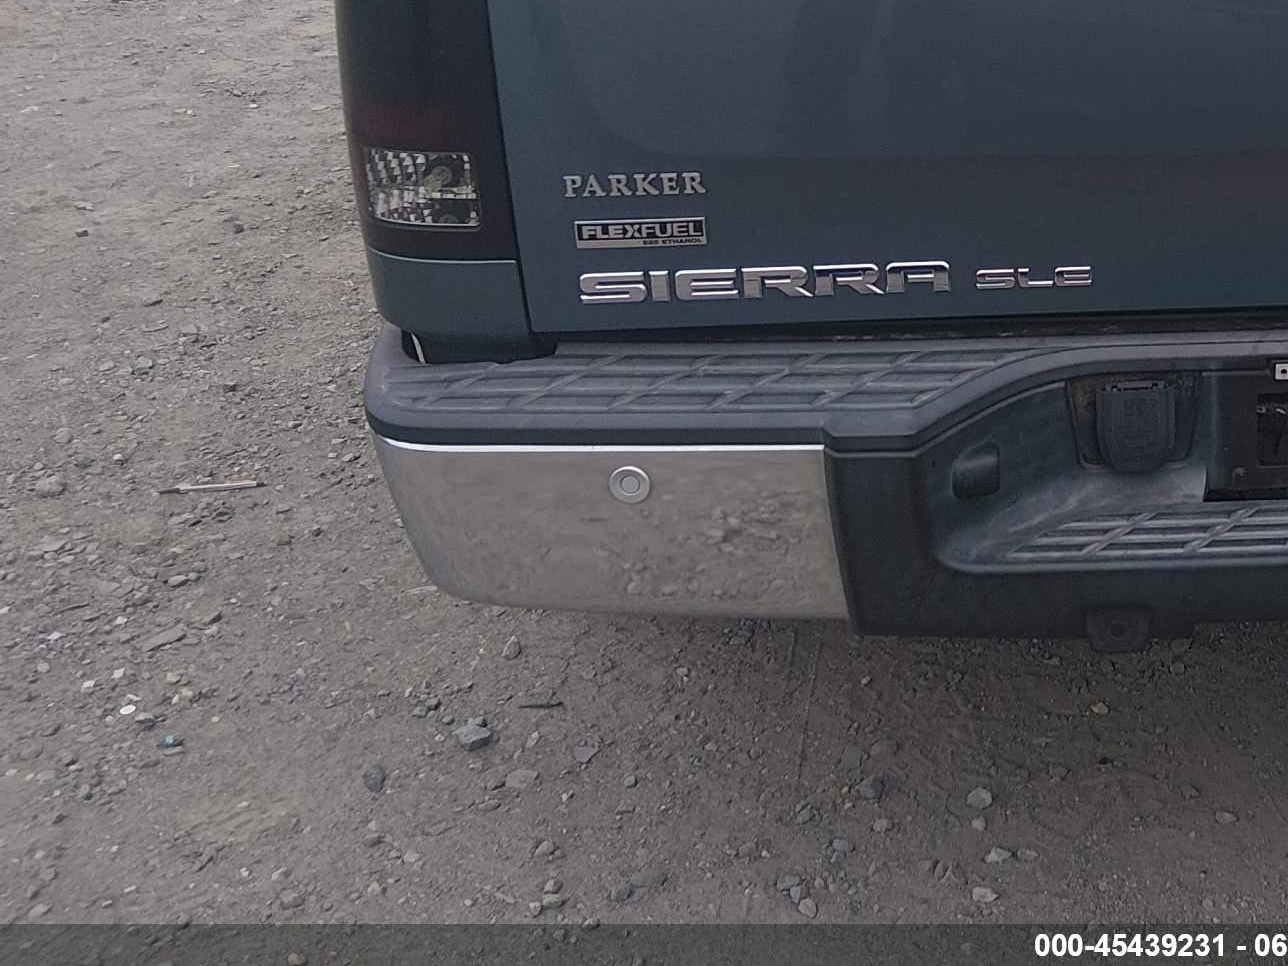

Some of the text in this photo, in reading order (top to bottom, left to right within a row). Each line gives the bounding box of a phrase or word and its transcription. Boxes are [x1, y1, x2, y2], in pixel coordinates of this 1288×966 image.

[563, 172, 706, 198] PARKER
[581, 222, 702, 240] FLEXFUEL
[579, 260, 1092, 305] SIERRA SLE
